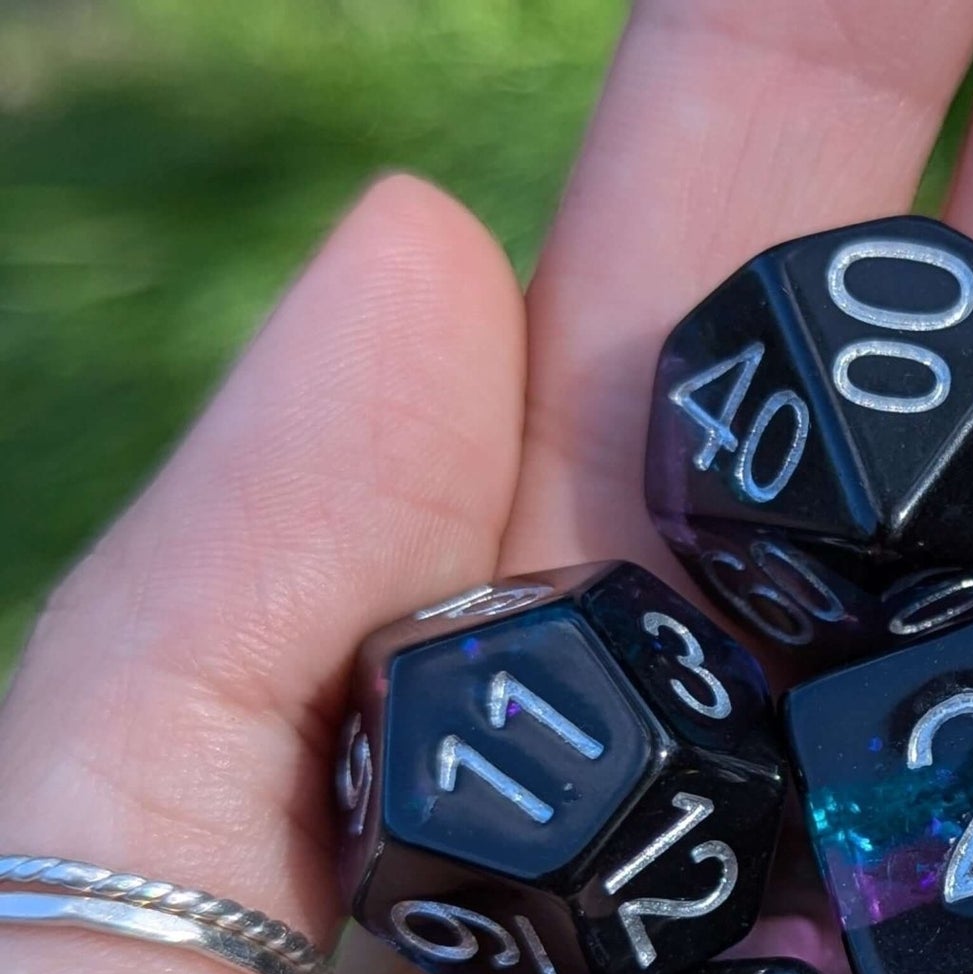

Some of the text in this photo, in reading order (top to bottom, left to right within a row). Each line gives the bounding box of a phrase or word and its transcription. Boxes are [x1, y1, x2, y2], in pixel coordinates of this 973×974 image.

[668, 341, 810, 503] 40
[642, 611, 733, 720] 3
[437, 671, 605, 824] 11
[605, 791, 739, 969] 12
